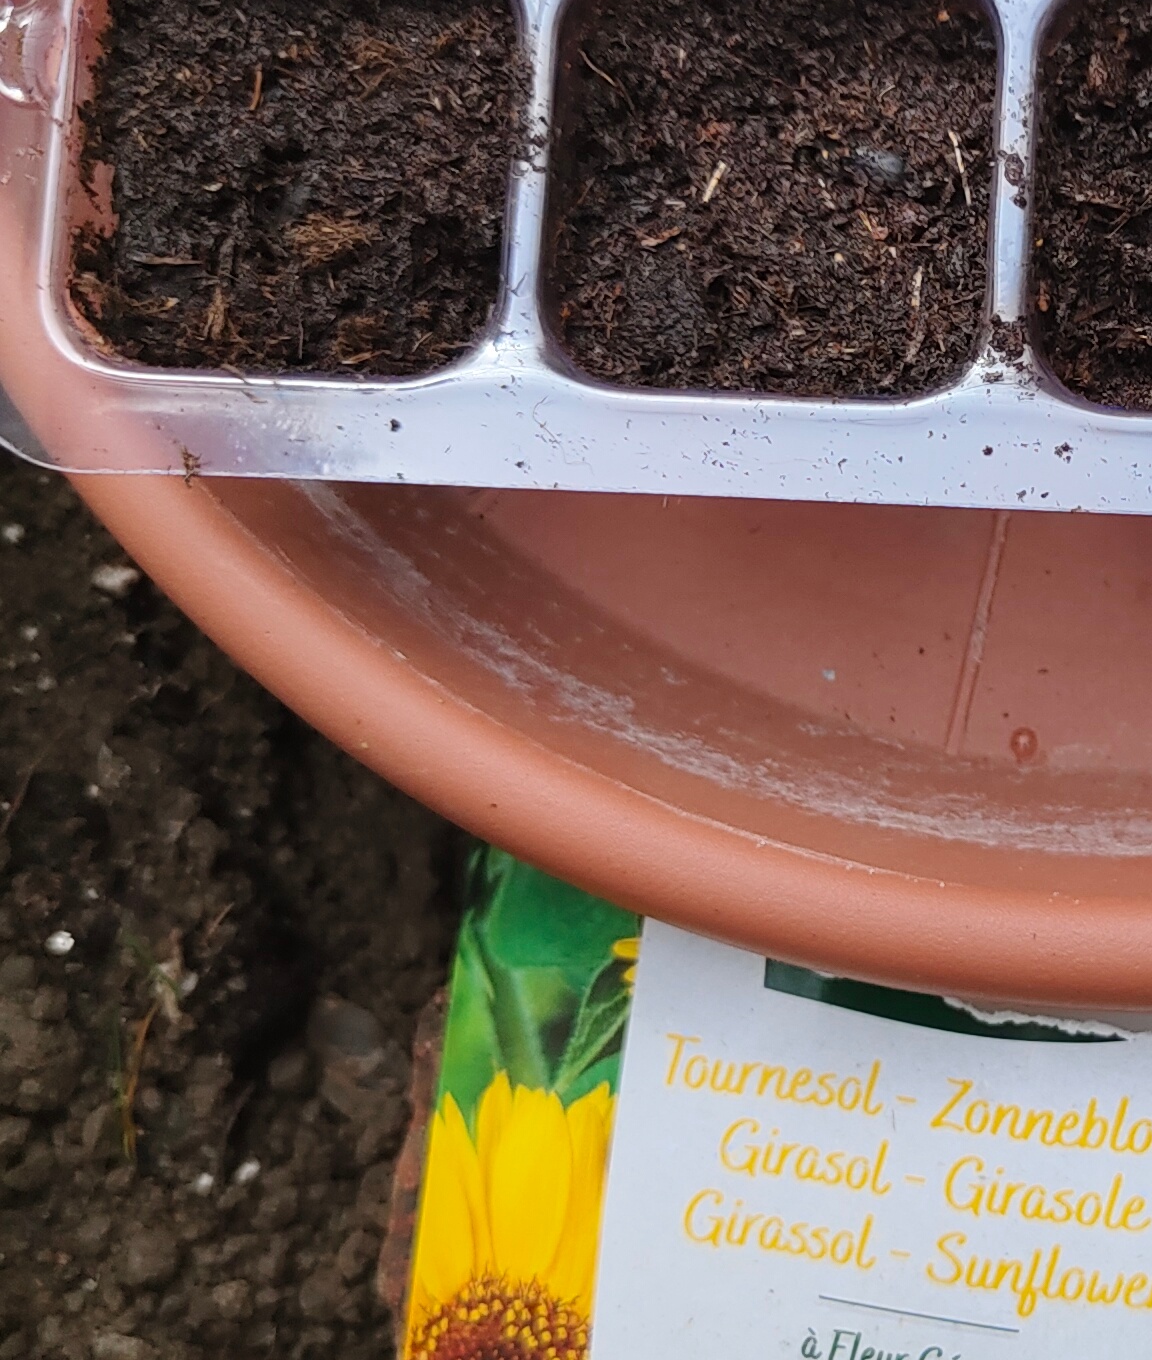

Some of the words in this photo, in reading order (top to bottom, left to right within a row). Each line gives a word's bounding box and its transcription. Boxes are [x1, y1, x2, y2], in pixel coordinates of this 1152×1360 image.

[666, 1032, 883, 1115] Tournesol
[719, 1117, 891, 1195] Girasol
[944, 1154, 1152, 1231] Girasole
[683, 1188, 876, 1270] Girassol
[801, 1327, 822, 1360] à
